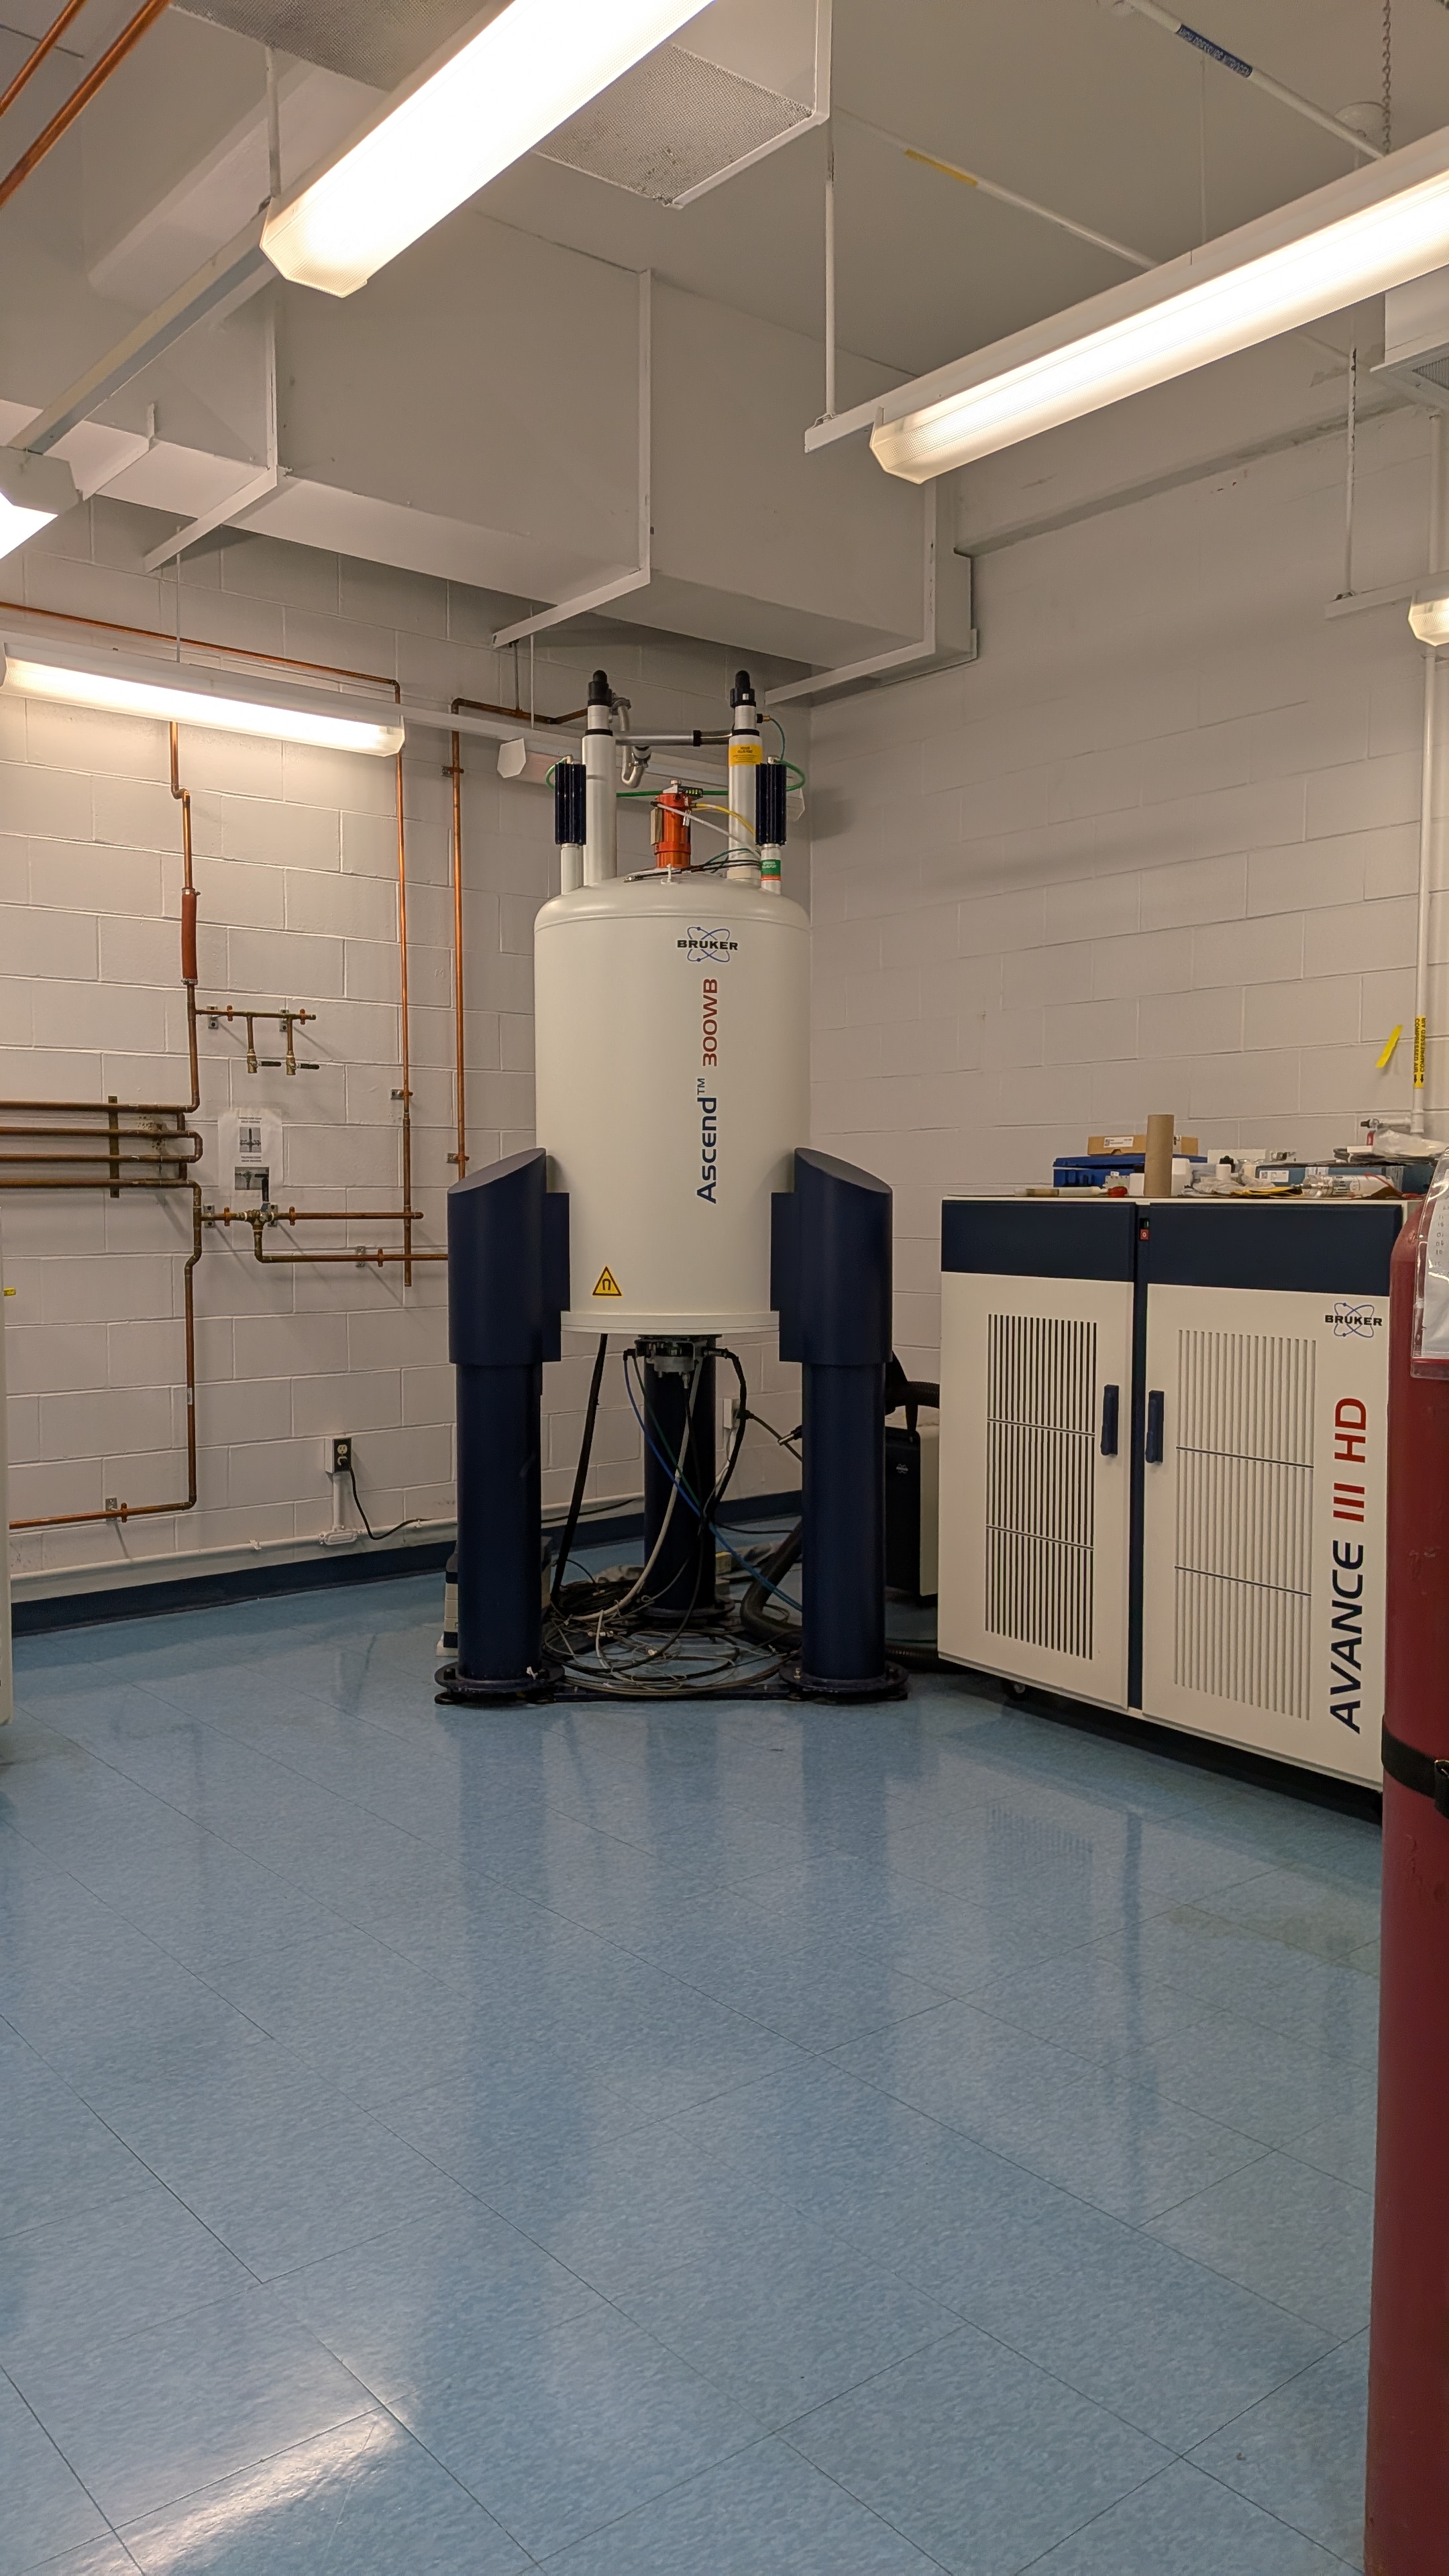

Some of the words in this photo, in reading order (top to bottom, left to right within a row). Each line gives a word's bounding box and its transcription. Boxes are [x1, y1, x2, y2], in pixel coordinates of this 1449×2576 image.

[677, 940, 738, 951] BRUKER
[702, 979, 718, 1067] 300WB
[1325, 1315, 1383, 1326] BRUKER
[1334, 1397, 1366, 1464] HD
[1330, 1540, 1364, 1735] AVANCE
